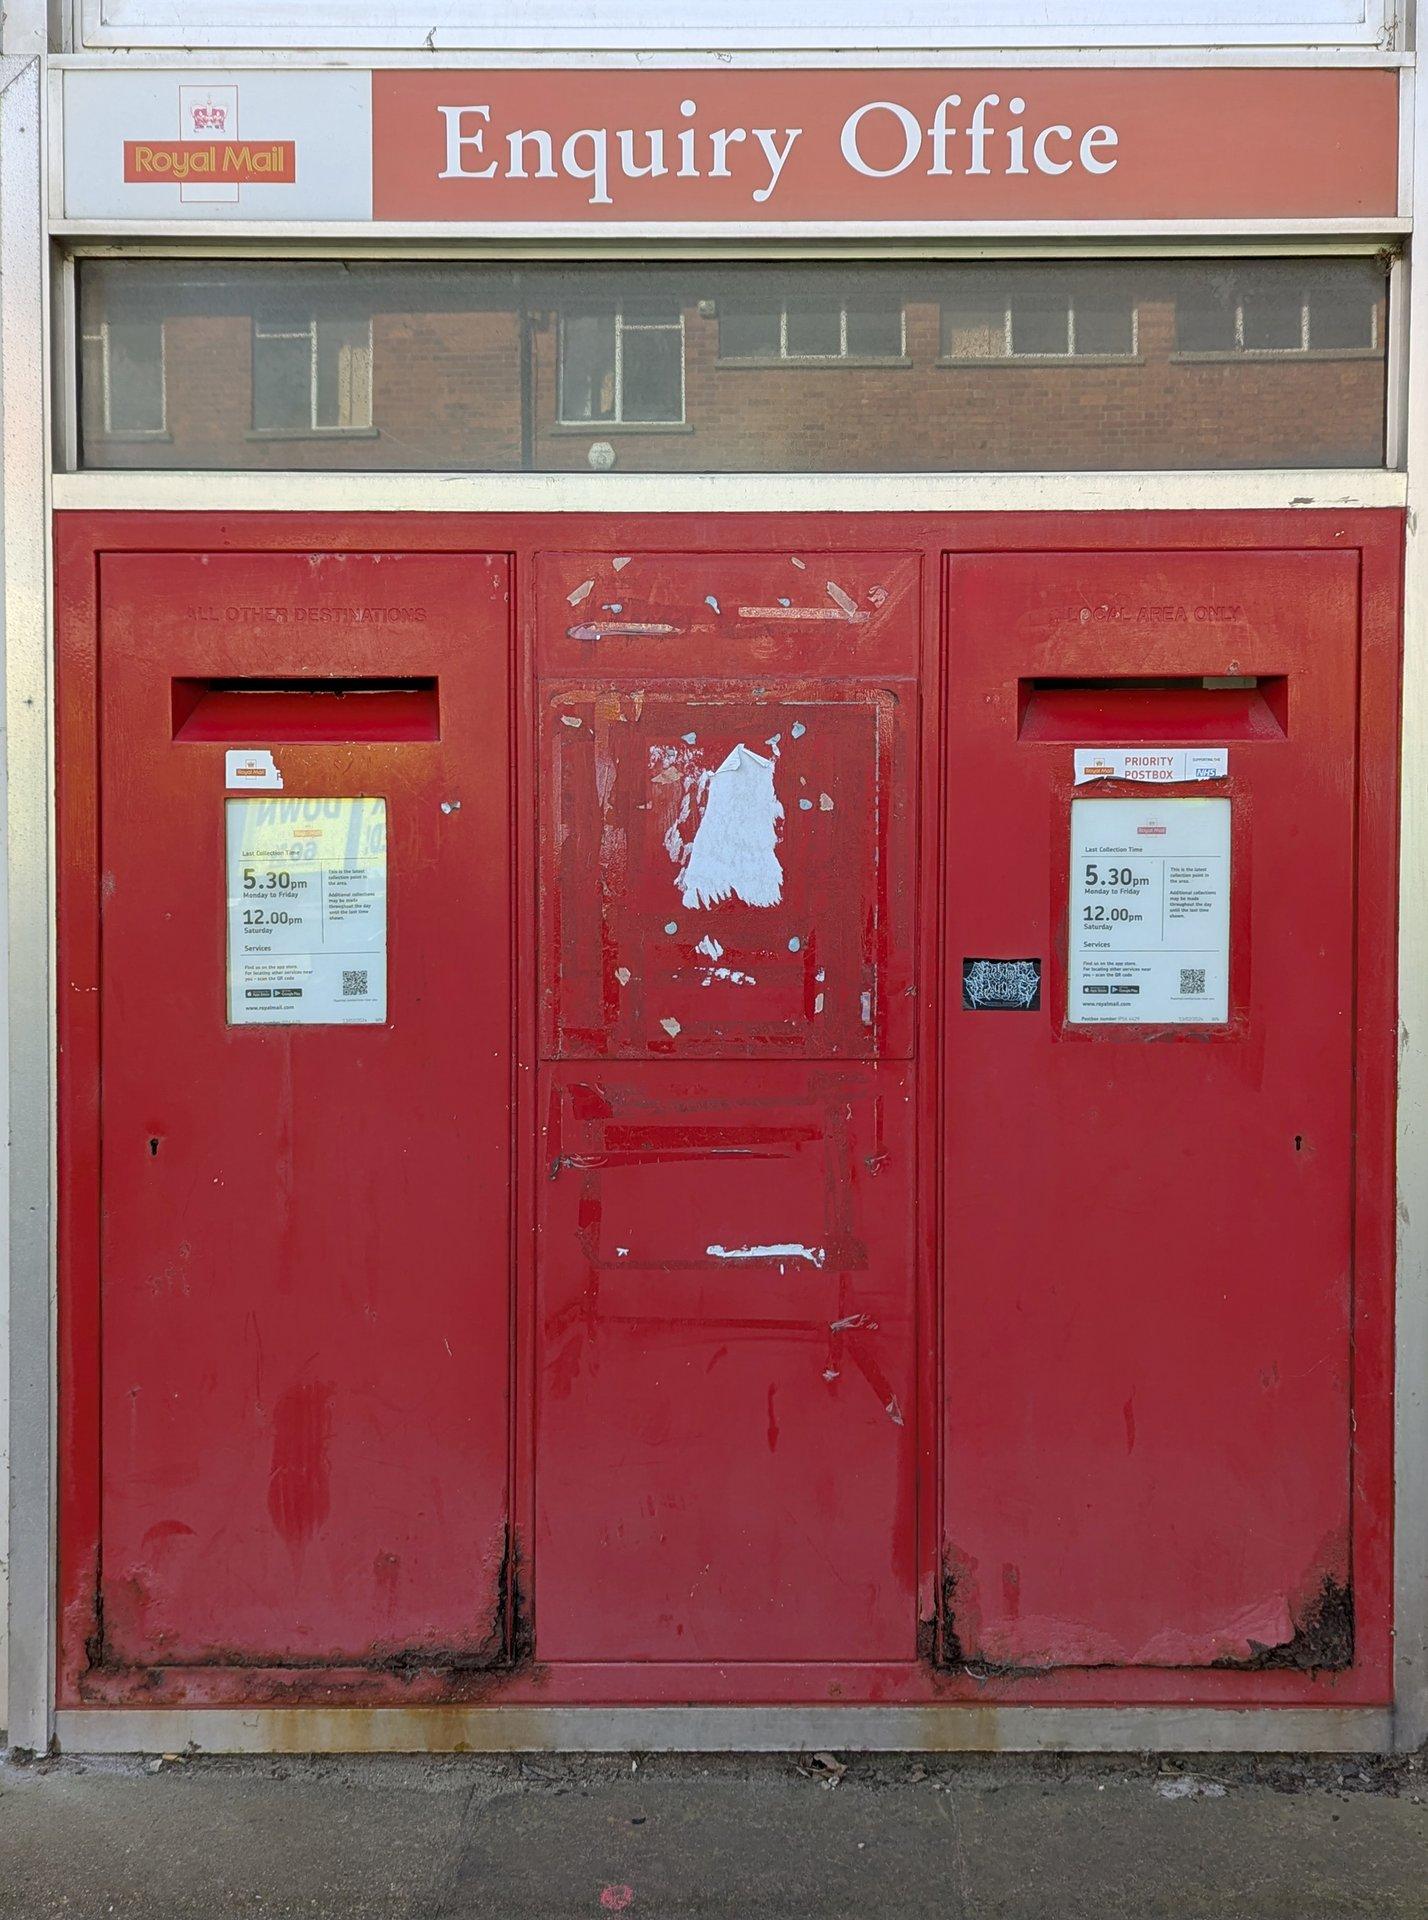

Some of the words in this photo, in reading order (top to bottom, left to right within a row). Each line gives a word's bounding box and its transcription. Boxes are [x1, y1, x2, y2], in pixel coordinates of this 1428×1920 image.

[437, 99, 802, 204] Enquiry
[840, 93, 1119, 178] Office
[135, 146, 215, 178] Royal
[222, 146, 284, 172] Mail
[225, 606, 288, 623] OTHER
[294, 607, 427, 623] DESTINATIONS
[1064, 605, 1131, 623] LOCAL
[1136, 606, 1188, 622] AREA
[1194, 606, 1240, 622] ONLY
[1125, 756, 1174, 766] PRIORITY
[1124, 770, 1173, 780] POSTBOX
[244, 868, 308, 890] 5.30pm
[1085, 864, 1150, 887] 5.30pm
[243, 910, 302, 925] 12.00pm
[1083, 906, 1142, 922] 12.00pm
